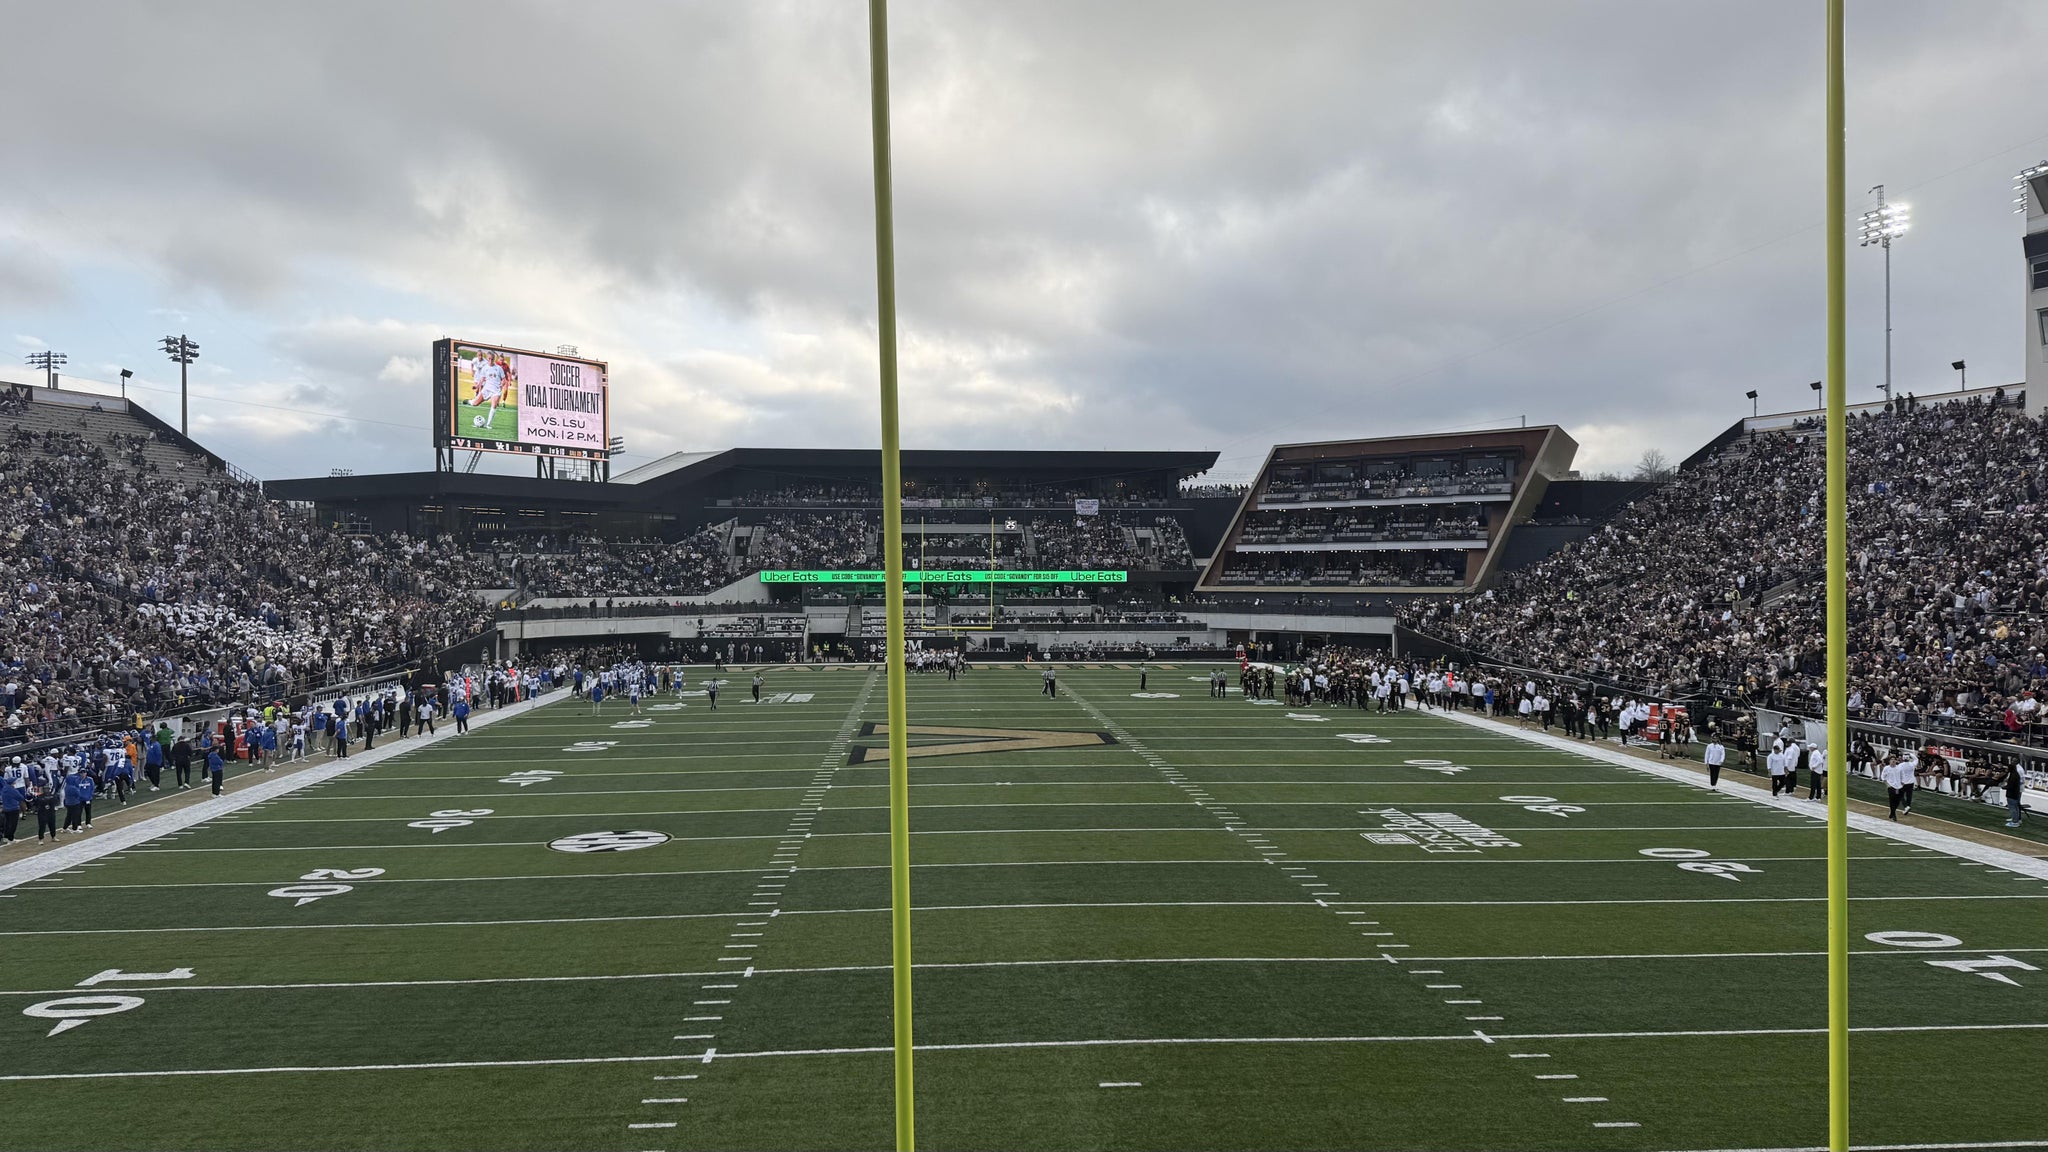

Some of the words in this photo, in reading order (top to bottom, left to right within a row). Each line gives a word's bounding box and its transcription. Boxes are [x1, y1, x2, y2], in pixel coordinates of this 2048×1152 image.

[550, 362, 581, 388] SOCCER
[525, 384, 548, 409] NCAA
[549, 387, 600, 415] TOURNAMENT
[541, 416, 560, 427] VS.
[563, 418, 586, 429] LSU
[527, 427, 559, 439] MON.
[577, 432, 599, 444] P.M.
[764, 572, 790, 581] Uber
[793, 572, 819, 582] Eats
[919, 571, 944, 581] Uber
[947, 571, 972, 581] Eats
[1070, 572, 1095, 581] Uber
[1097, 572, 1122, 582] Eats
[110, 752, 120, 761] 76
[11, 769, 22, 779] 16
[1411, 812, 1523, 847] STADIUM
[1638, 847, 1765, 874] 20
[267, 867, 386, 898] 20
[1863, 930, 2043, 973] 10
[22, 967, 197, 1018] 10
